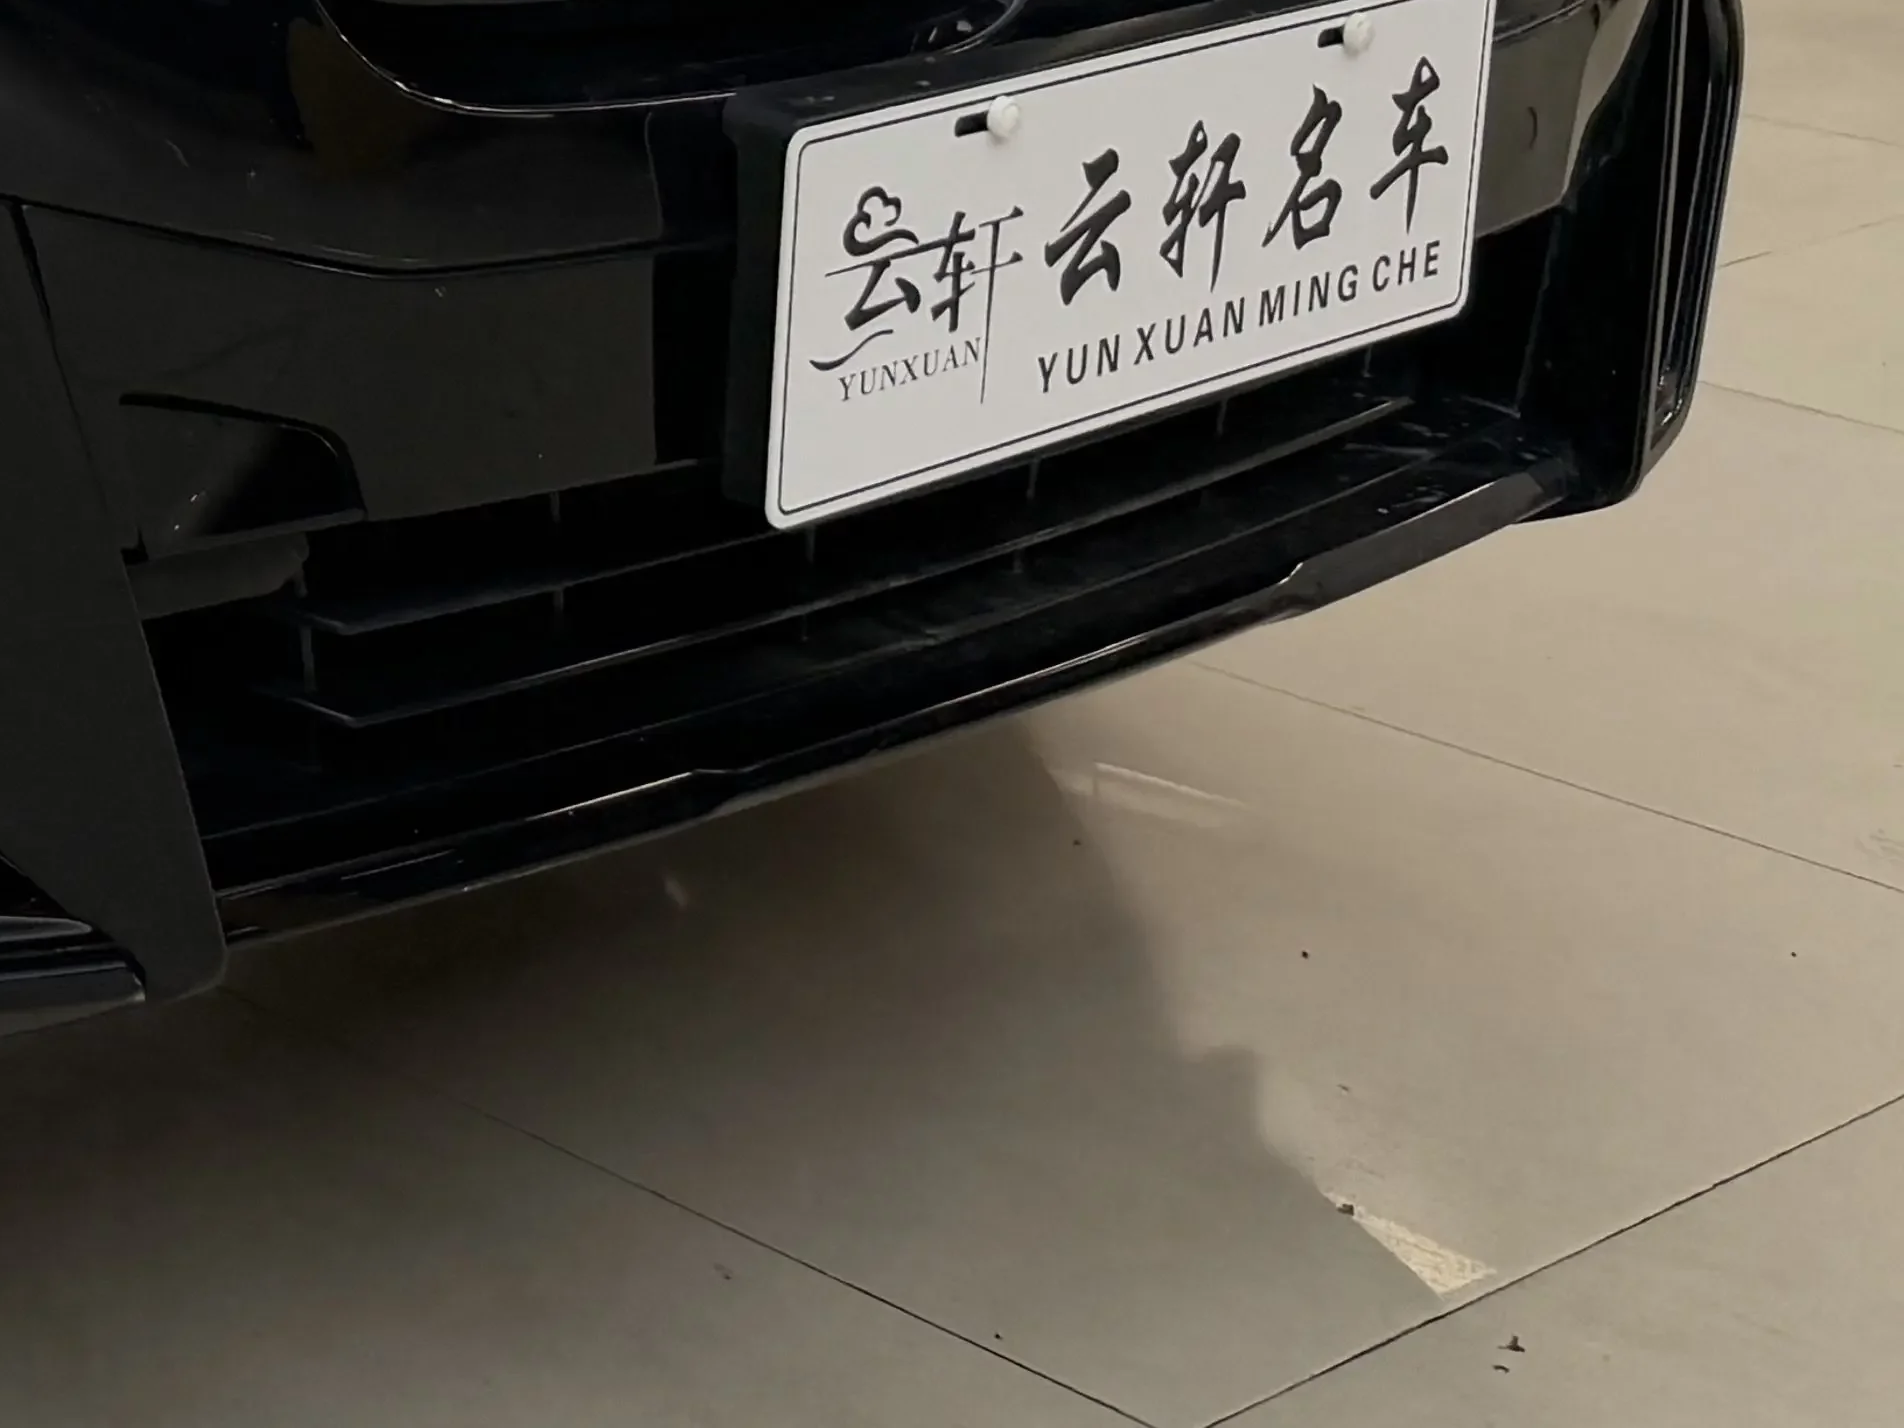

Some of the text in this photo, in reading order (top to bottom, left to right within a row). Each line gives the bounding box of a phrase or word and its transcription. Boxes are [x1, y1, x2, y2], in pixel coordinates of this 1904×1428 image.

[1043, 56, 1450, 306] 云轩名车
[837, 336, 983, 403] YUNXUAN
[1036, 239, 1442, 394] YUN XUAN MING CHE
